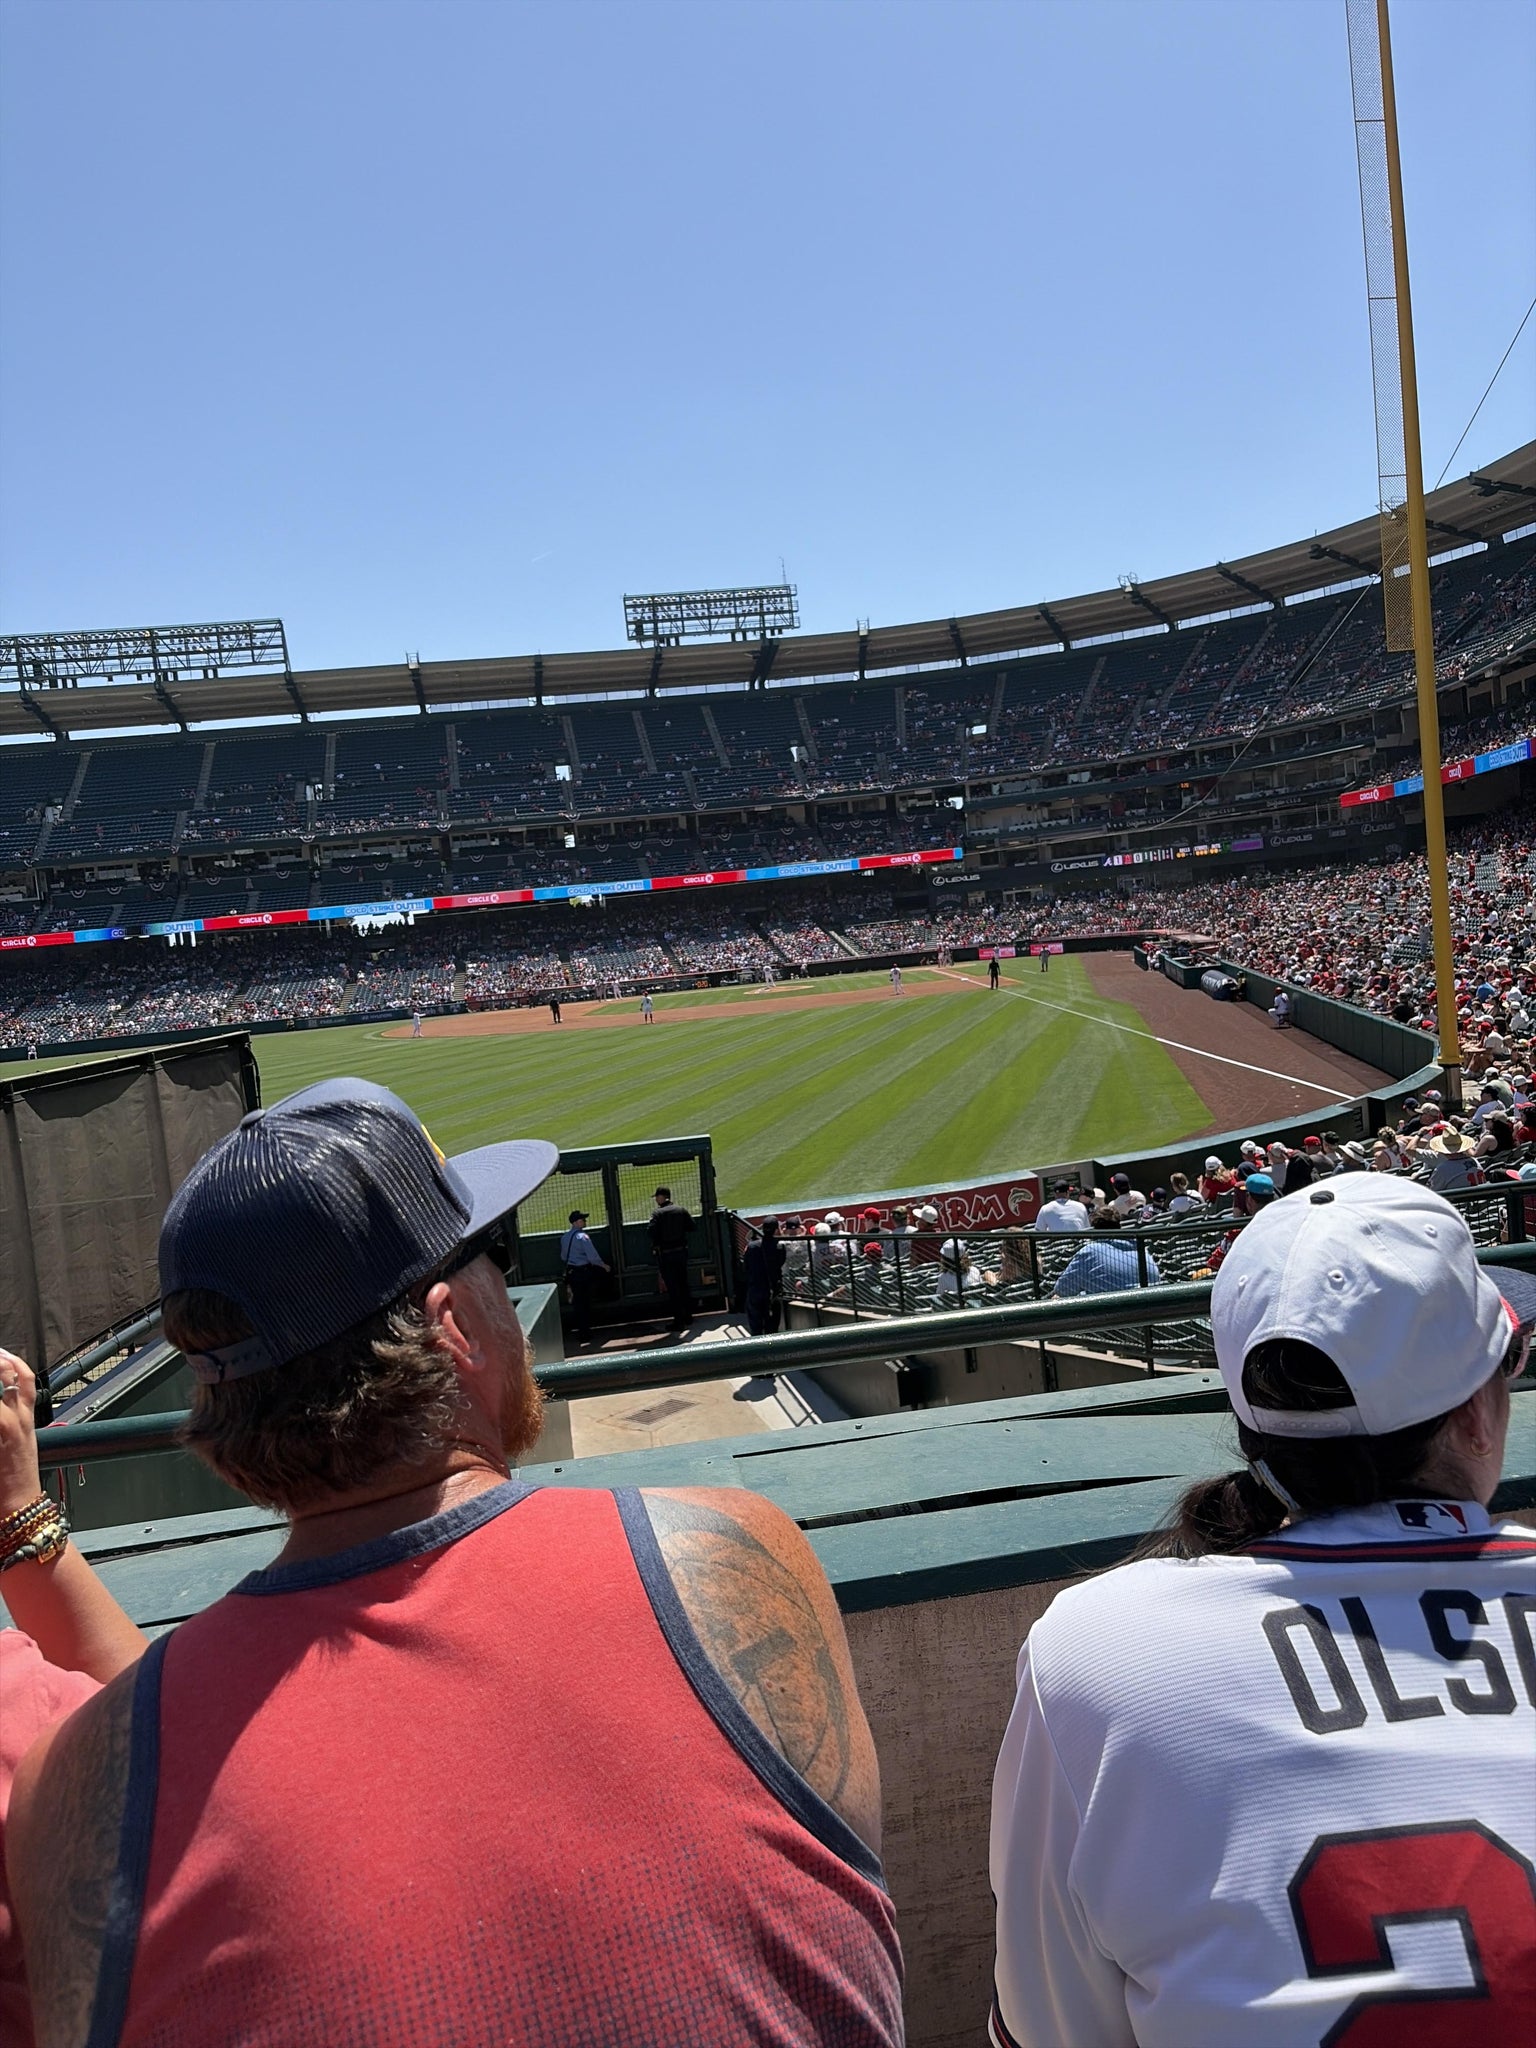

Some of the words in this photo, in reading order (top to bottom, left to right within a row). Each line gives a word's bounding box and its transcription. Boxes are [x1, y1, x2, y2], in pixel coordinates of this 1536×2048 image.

[1281, 833, 1313, 845] LEXUS
[890, 855, 911, 864] CIRCLE
[778, 866, 799, 876] COLD
[800, 864, 825, 874] STRIKE
[1063, 860, 1099, 871] LEXUS
[683, 875, 705, 884] CIRCLE
[945, 874, 981, 884] LEXUS
[567, 886, 589, 896] COLD
[590, 883, 616, 893] STRIKE
[467, 895, 489, 905] CIRCLE
[344, 906, 367, 916] COLD
[368, 903, 395, 913] STRIKE
[239, 915, 262, 925] CIRCLE
[1, 937, 26, 947] CIRCLE
